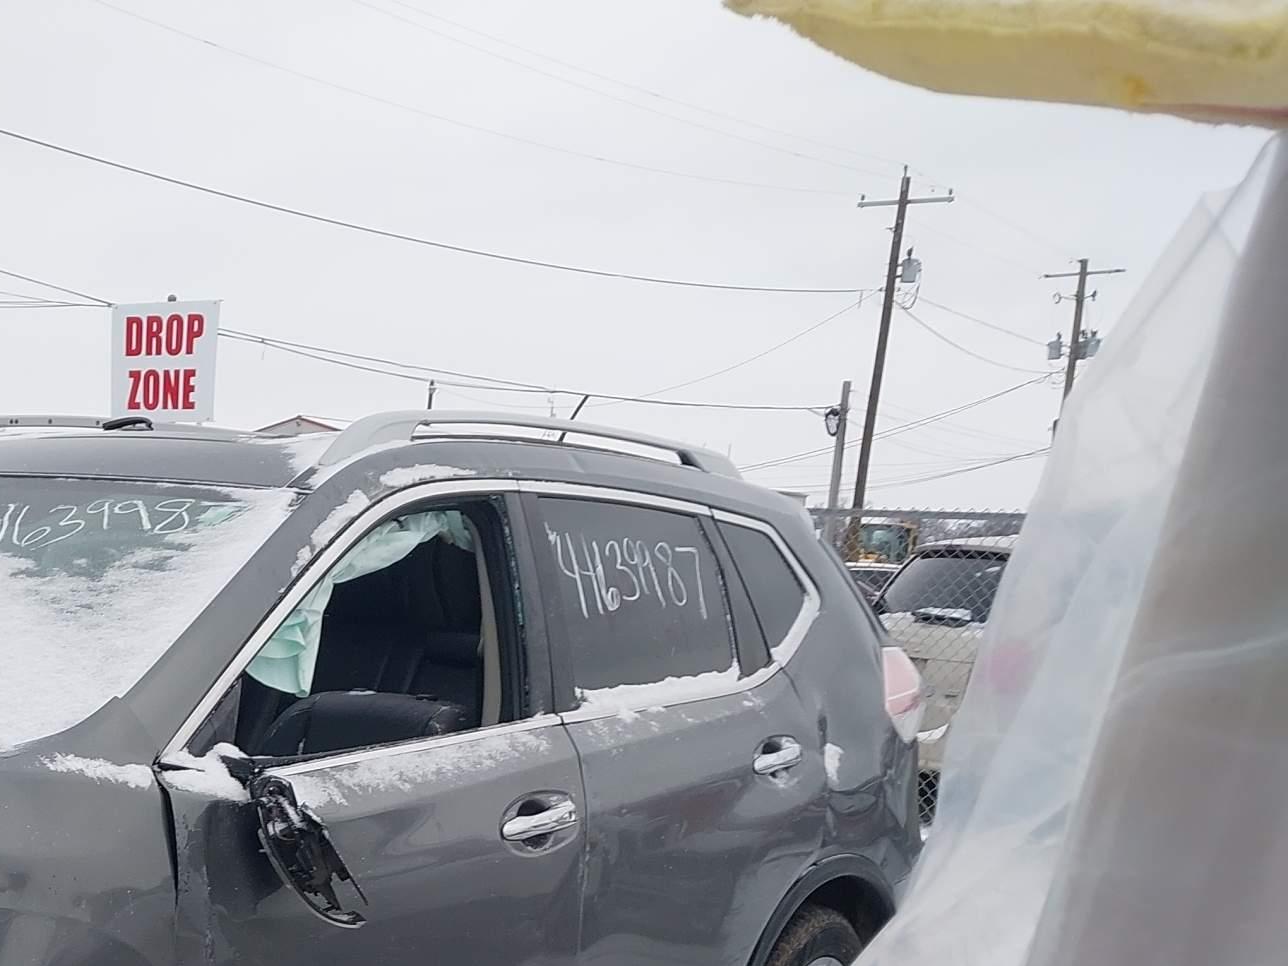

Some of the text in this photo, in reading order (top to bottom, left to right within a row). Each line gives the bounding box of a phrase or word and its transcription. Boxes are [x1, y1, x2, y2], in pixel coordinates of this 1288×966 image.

[124, 313, 205, 357] DROP
[127, 368, 197, 411] ZONE
[544, 521, 708, 620] 44639987
